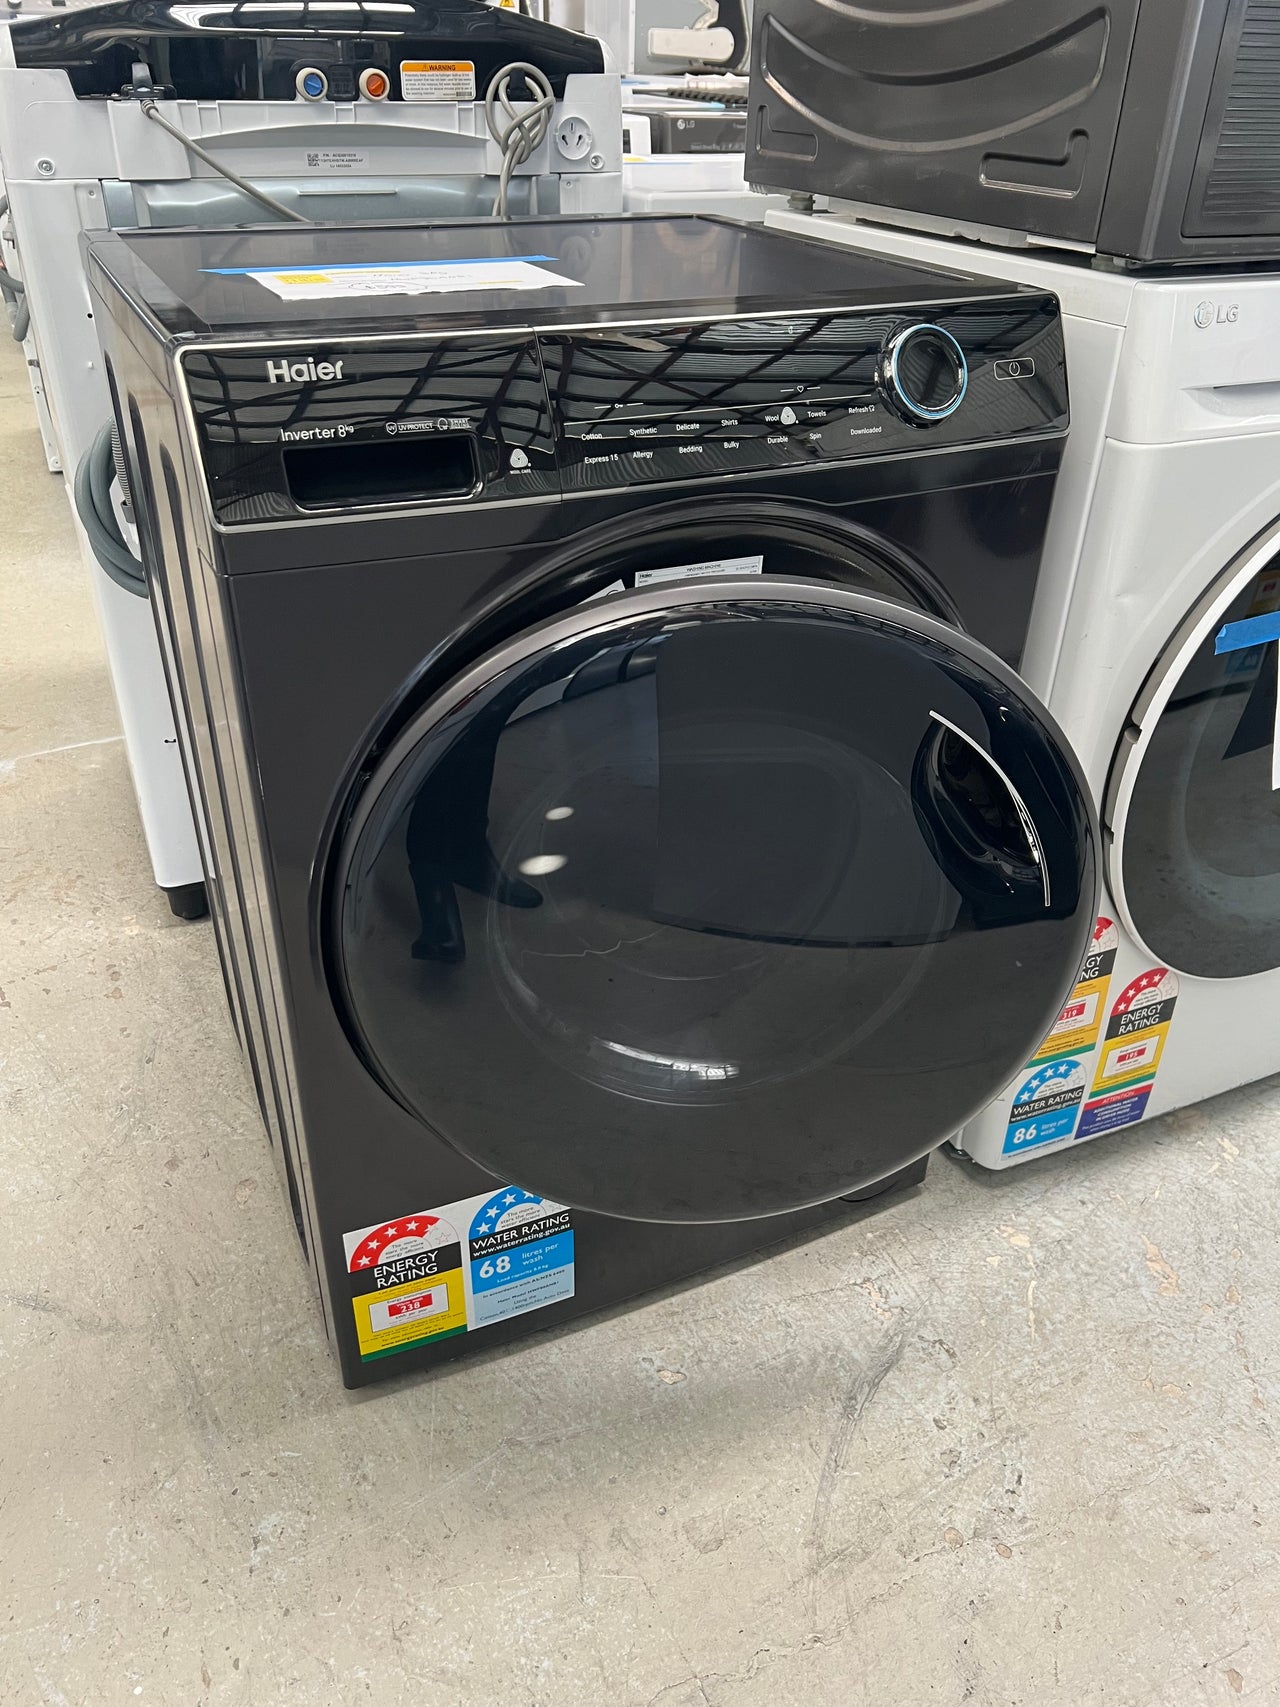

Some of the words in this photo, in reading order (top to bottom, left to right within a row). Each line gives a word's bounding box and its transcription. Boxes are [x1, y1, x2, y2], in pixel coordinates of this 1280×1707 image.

[686, 120, 696, 128] LG
[1216, 304, 1240, 324] LG
[266, 356, 344, 384] Haier
[720, 419, 739, 427] Shirts
[765, 414, 780, 422] Wool
[807, 410, 827, 418] Towels
[848, 406, 869, 414] Refresh
[280, 427, 336, 442] Inverter
[407, 422, 433, 430] PROTECT
[581, 433, 603, 441] Cotton
[629, 427, 658, 437] Synthetic
[675, 423, 700, 431] Delicate
[809, 432, 822, 440] Spin
[850, 426, 882, 435] Downloaded
[584, 454, 610, 464] Express
[610, 453, 619, 461] 15
[632, 450, 654, 459] Allergy
[678, 445, 703, 454] Bedding
[723, 441, 740, 449] Bulky
[767, 436, 789, 445] Durable
[1062, 1009, 1077, 1020] 319
[1120, 1002, 1164, 1025] ENERGY
[1118, 1014, 1160, 1035] RATING
[1125, 1051, 1138, 1061] 195
[1013, 1100, 1046, 1115] WATER
[1047, 1089, 1083, 1104] RATING
[1013, 1123, 1037, 1144] 86
[472, 1229, 519, 1250] WATER
[522, 1213, 570, 1236] RATING
[472, 1223, 571, 1257] www.waterrating.gov.au
[373, 1250, 439, 1278] ENERGY
[479, 1255, 512, 1279] 68
[522, 1248, 543, 1259] litres
[545, 1242, 559, 1253] per
[522, 1255, 544, 1266] wash
[377, 1263, 438, 1289] RATING
[400, 1301, 421, 1313] 238
